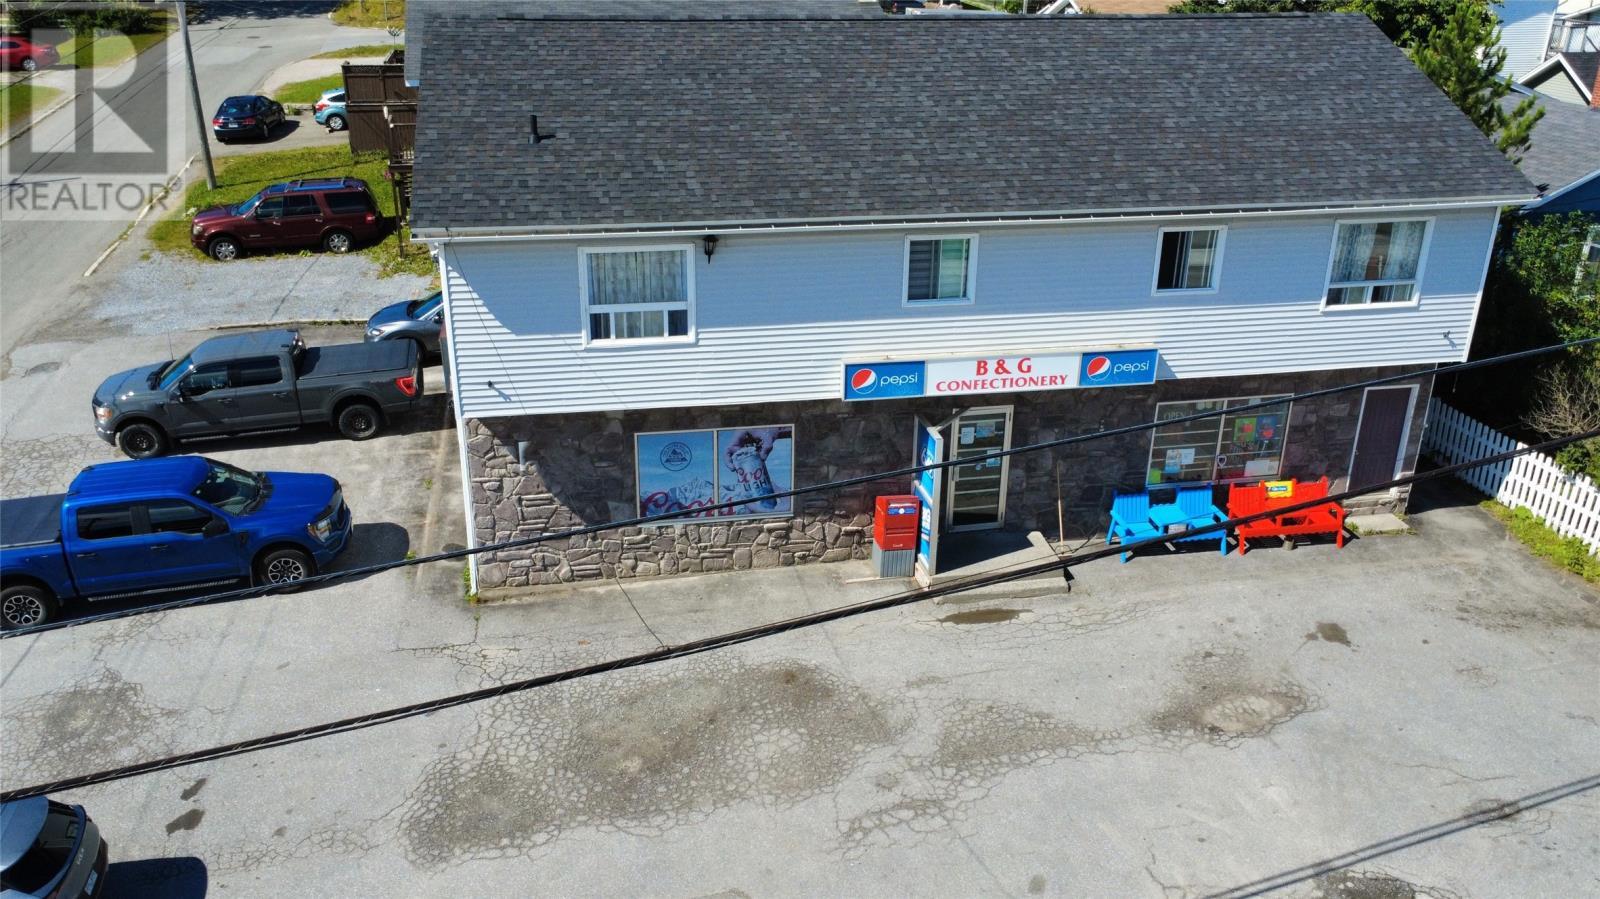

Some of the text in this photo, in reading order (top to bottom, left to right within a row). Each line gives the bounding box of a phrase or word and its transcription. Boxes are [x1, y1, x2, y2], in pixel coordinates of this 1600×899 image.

[976, 357, 1032, 376] B & G
[1113, 360, 1149, 375] pepsi
[880, 373, 918, 387] pepsi
[936, 375, 1068, 392] CONFECTIONERY
